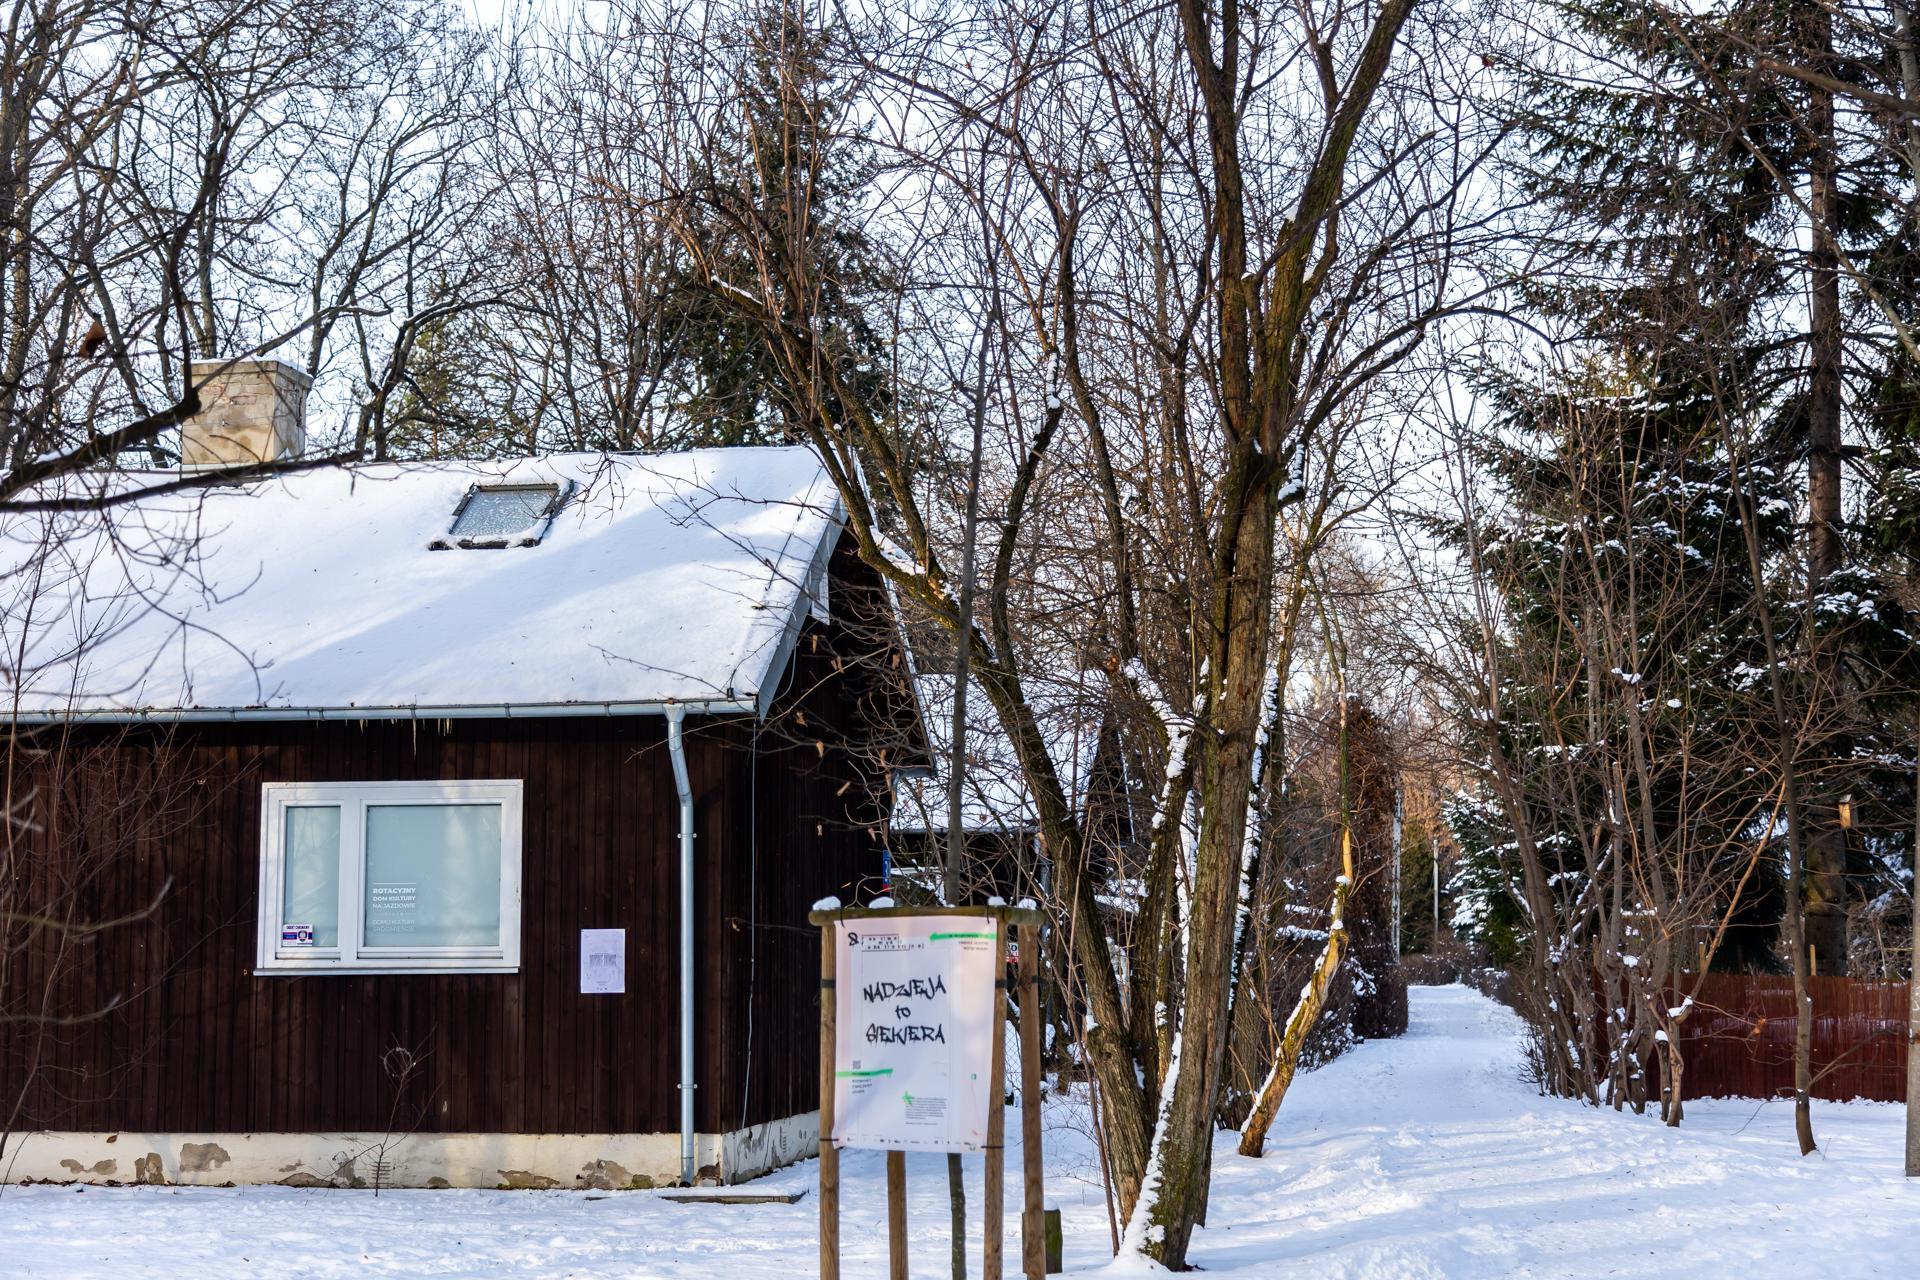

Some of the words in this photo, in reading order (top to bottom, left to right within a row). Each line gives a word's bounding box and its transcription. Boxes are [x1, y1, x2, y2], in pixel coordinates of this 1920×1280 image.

[863, 974, 947, 1003] NADZIEJA
[895, 1005, 912, 1020] to
[866, 1023, 946, 1046] SIEKIERA
